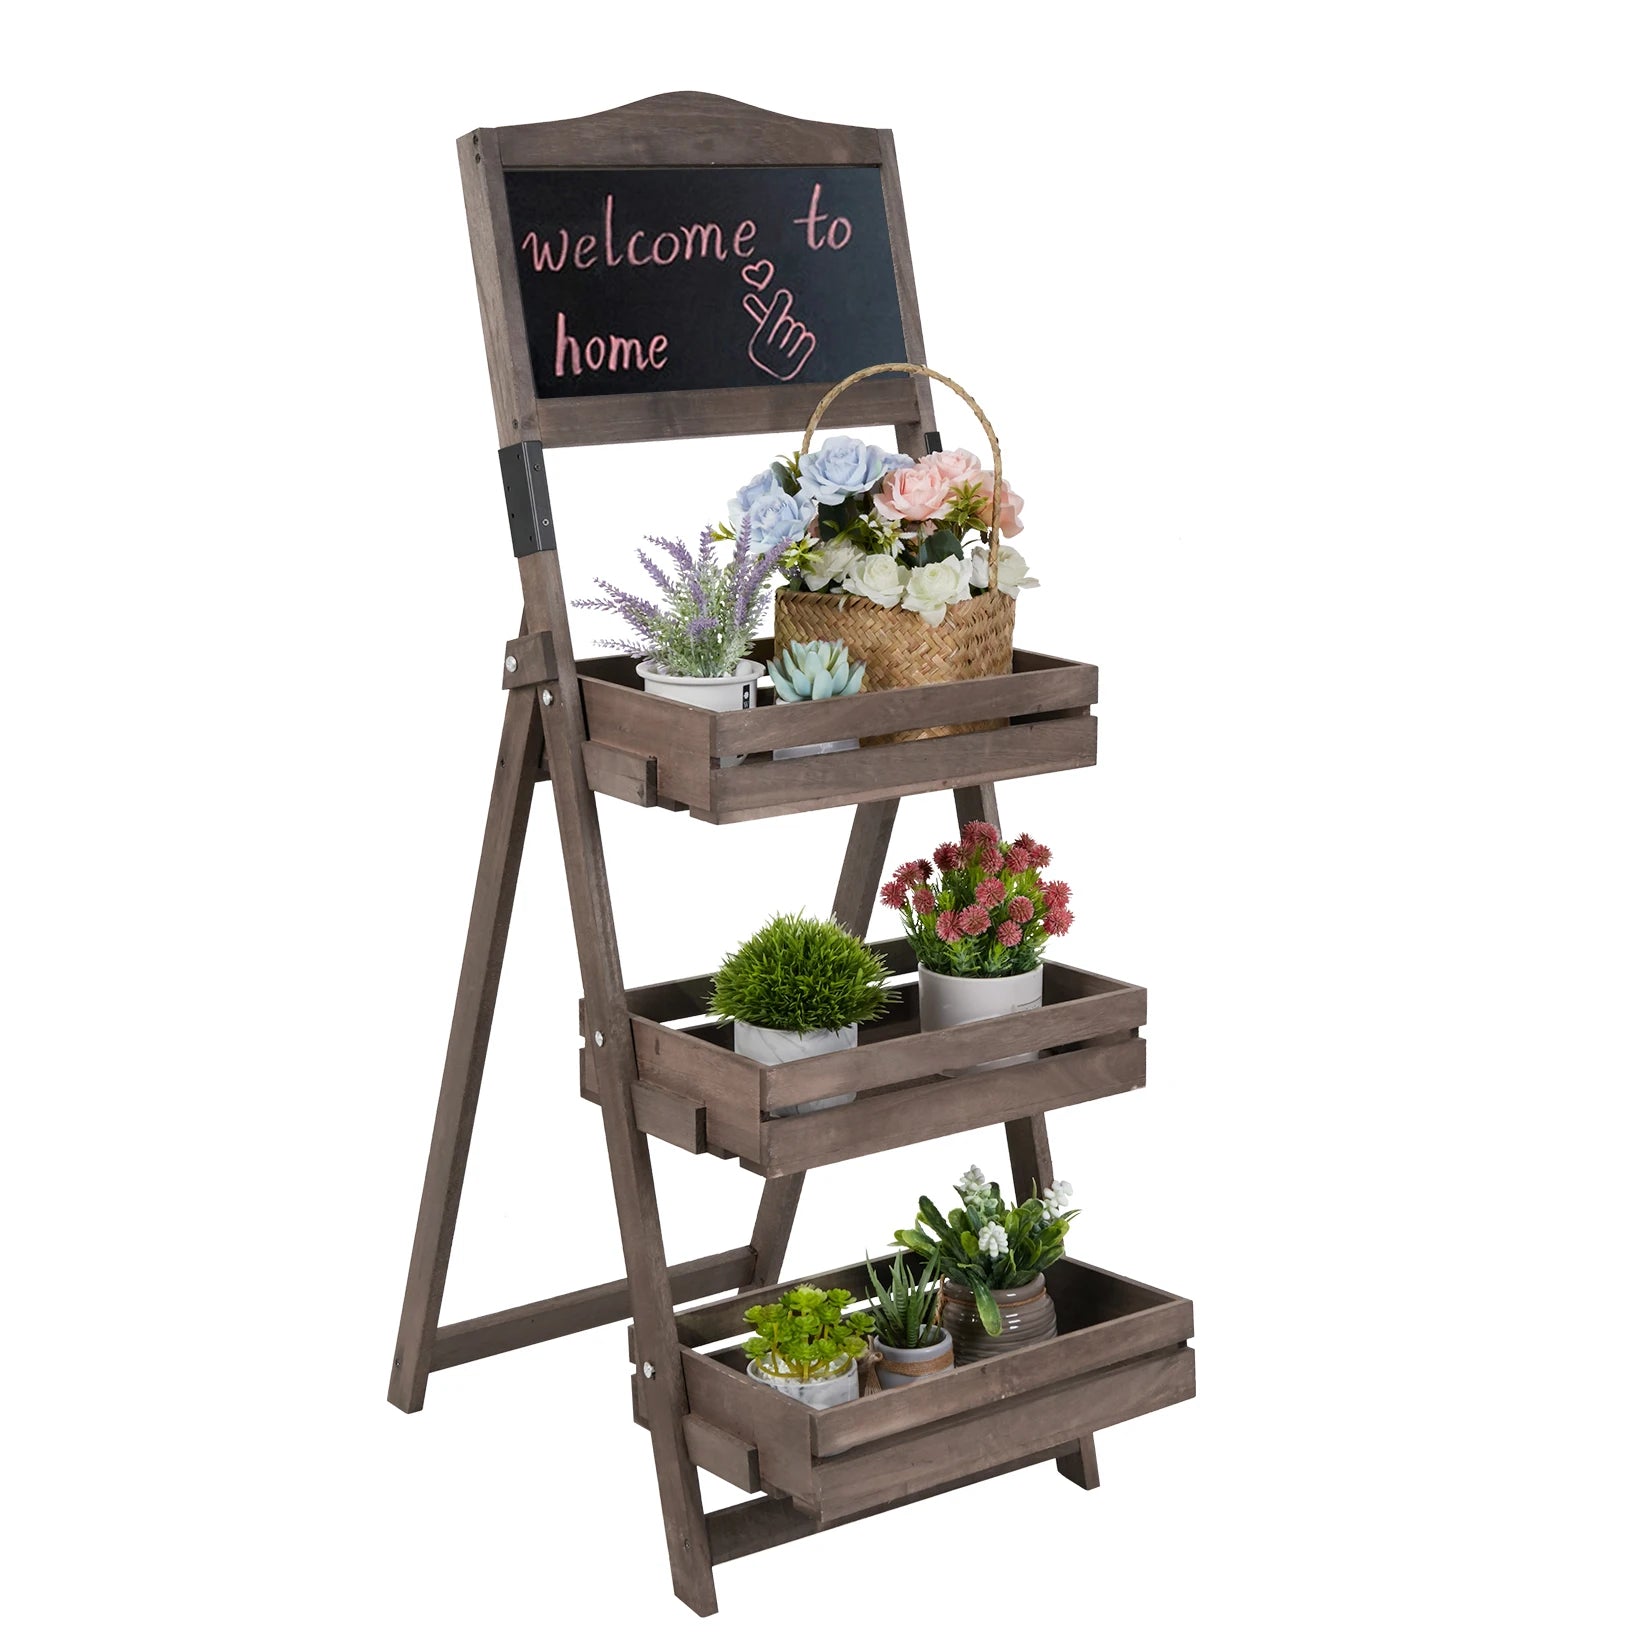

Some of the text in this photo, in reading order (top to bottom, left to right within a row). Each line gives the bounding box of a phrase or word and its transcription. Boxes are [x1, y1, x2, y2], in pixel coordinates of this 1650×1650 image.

[521, 183, 853, 272] welcome to
[554, 312, 669, 377] home
